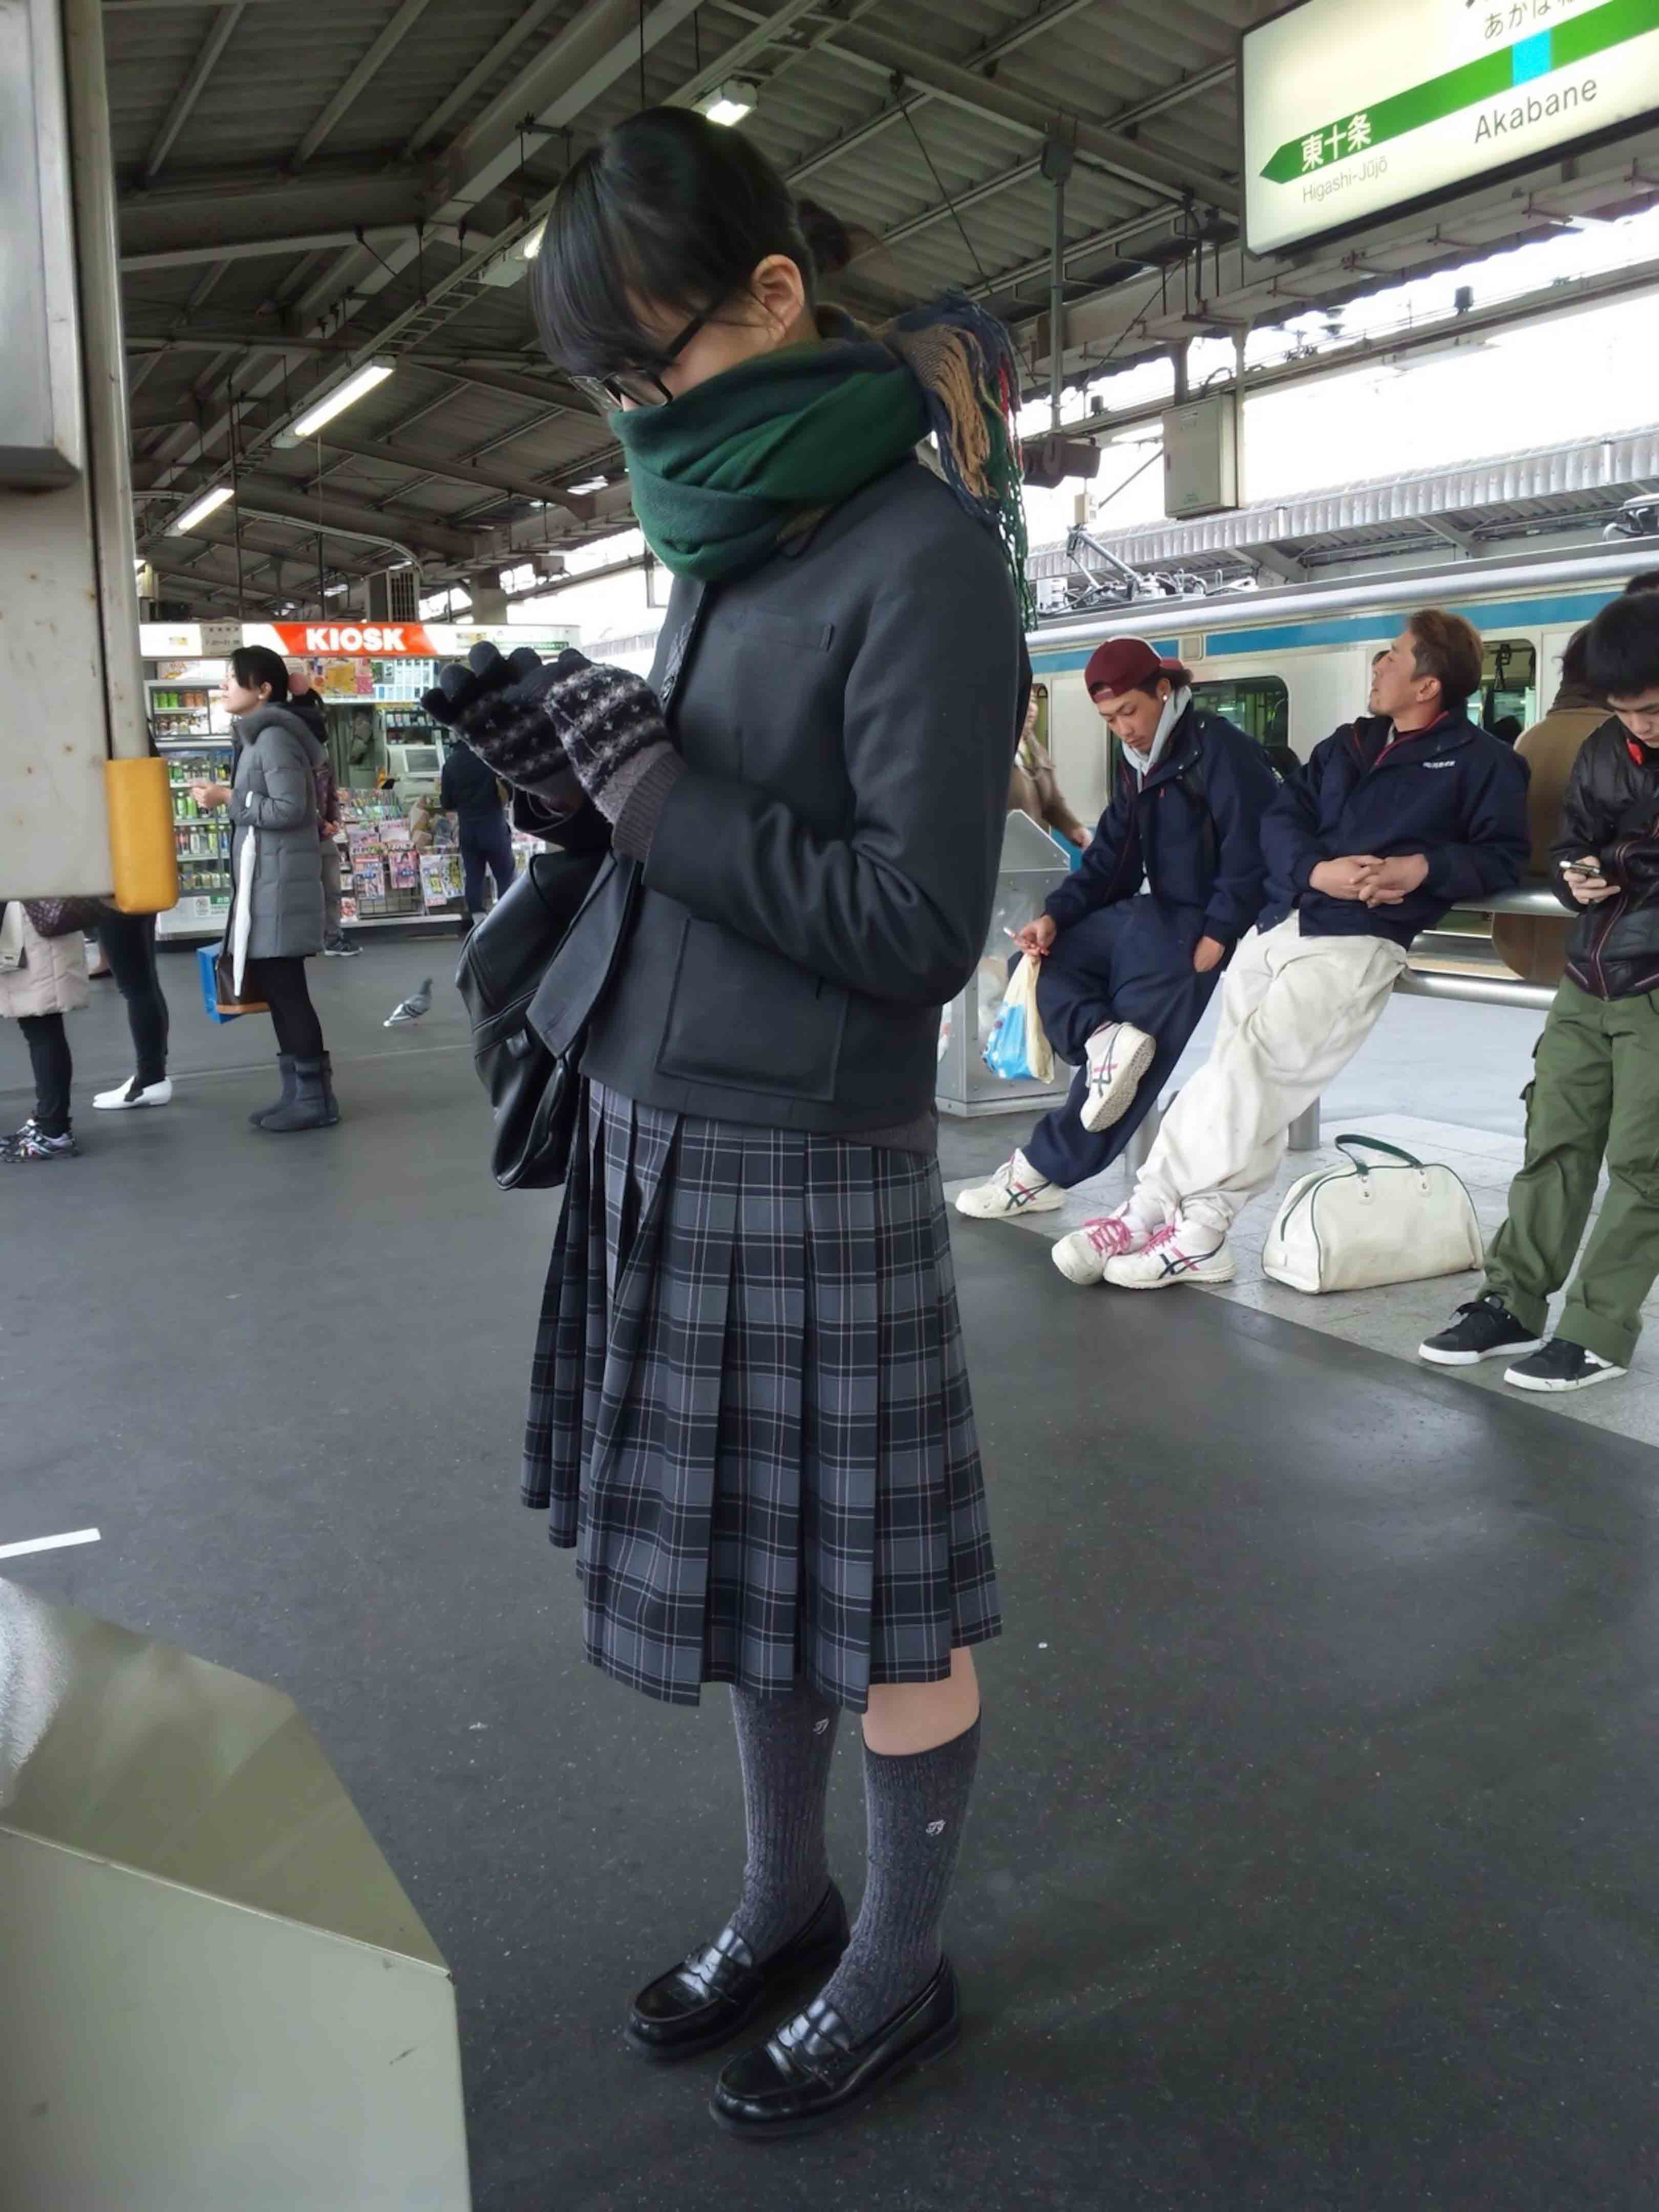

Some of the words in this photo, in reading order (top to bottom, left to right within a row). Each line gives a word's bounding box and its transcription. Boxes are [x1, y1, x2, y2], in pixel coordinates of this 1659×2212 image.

[1475, 79, 1597, 144] Akabane
[1301, 113, 1371, 172] 東十条
[1302, 155, 1388, 203] Higashi-Jūjō
[306, 627, 407, 651] KIOSK
